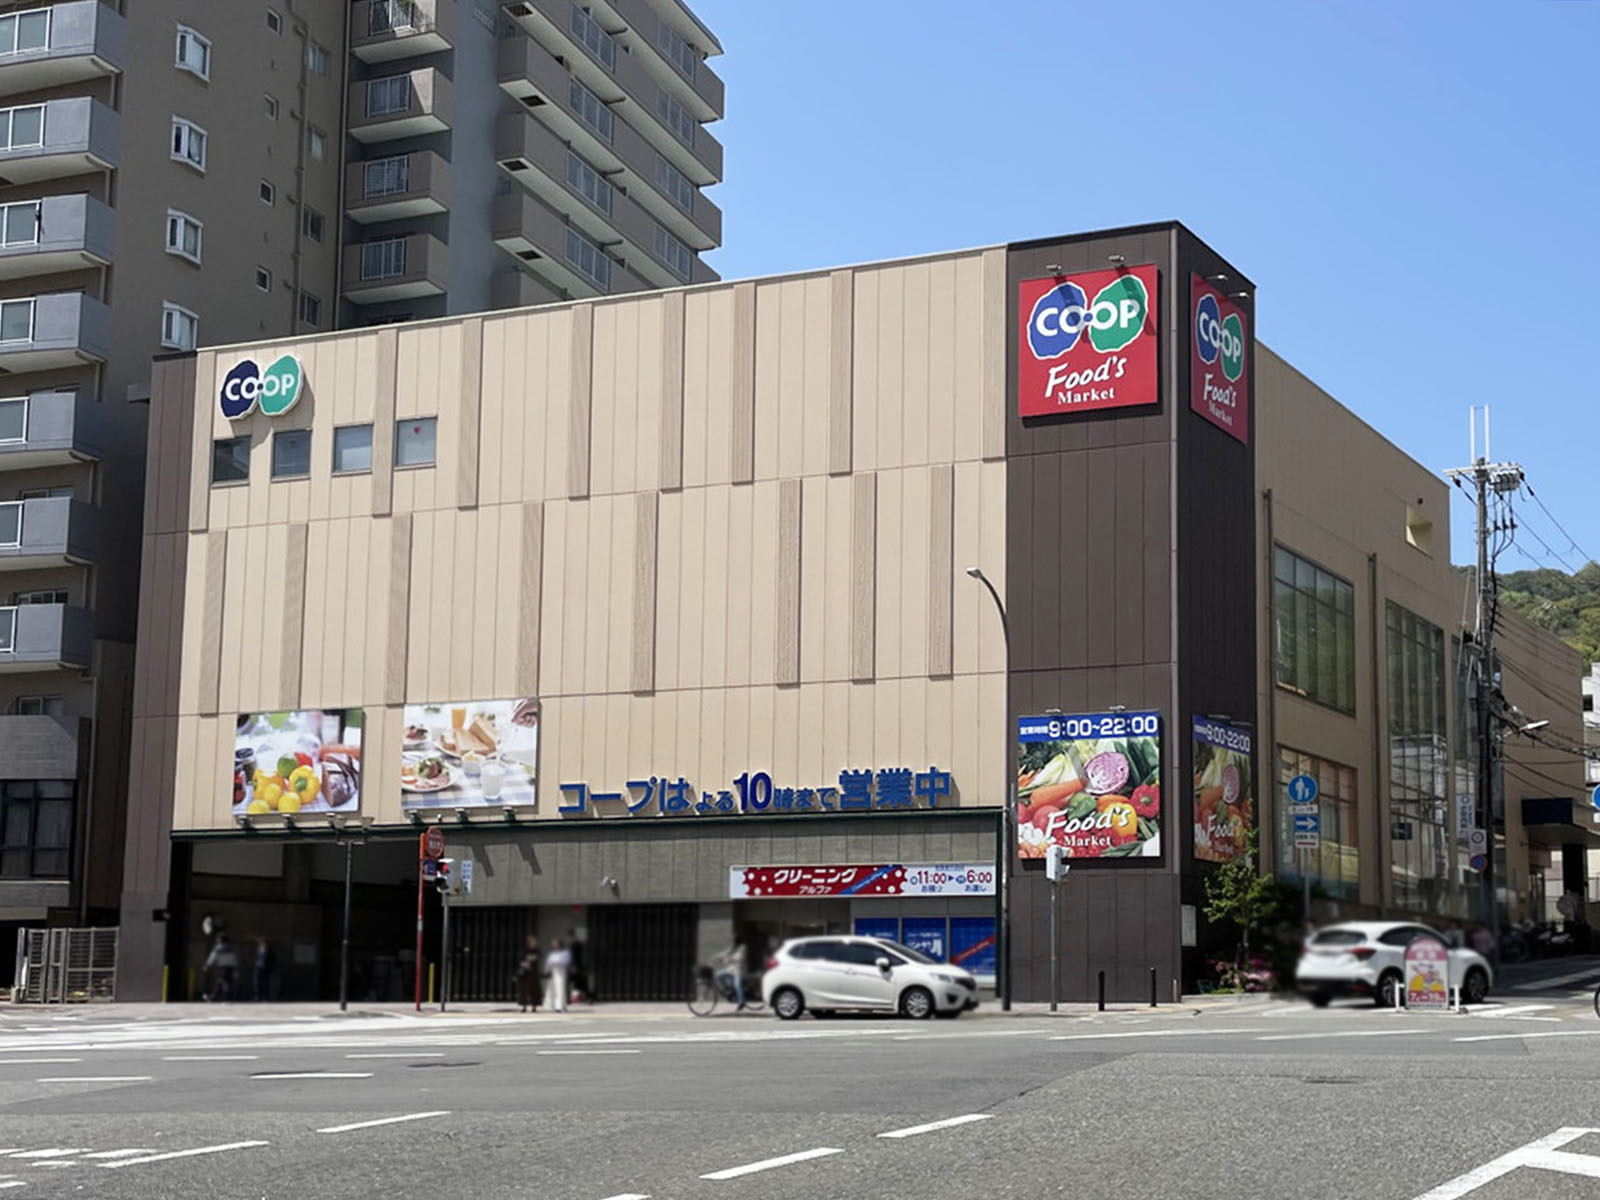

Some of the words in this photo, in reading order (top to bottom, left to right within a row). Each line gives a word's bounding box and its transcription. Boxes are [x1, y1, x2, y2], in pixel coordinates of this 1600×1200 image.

[1044, 355, 1127, 398] Food's
[1057, 387, 1115, 405] Market
[1203, 373, 1236, 408] Food's
[558, 765, 952, 814] コープはよる10時まで営業中
[1043, 806, 1131, 841] Food's
[1063, 835, 1112, 848] Market
[774, 868, 858, 884] クリーニング
[917, 870, 947, 884] 11:00
[967, 869, 992, 884] 6:00
[799, 885, 832, 895] アルファ
